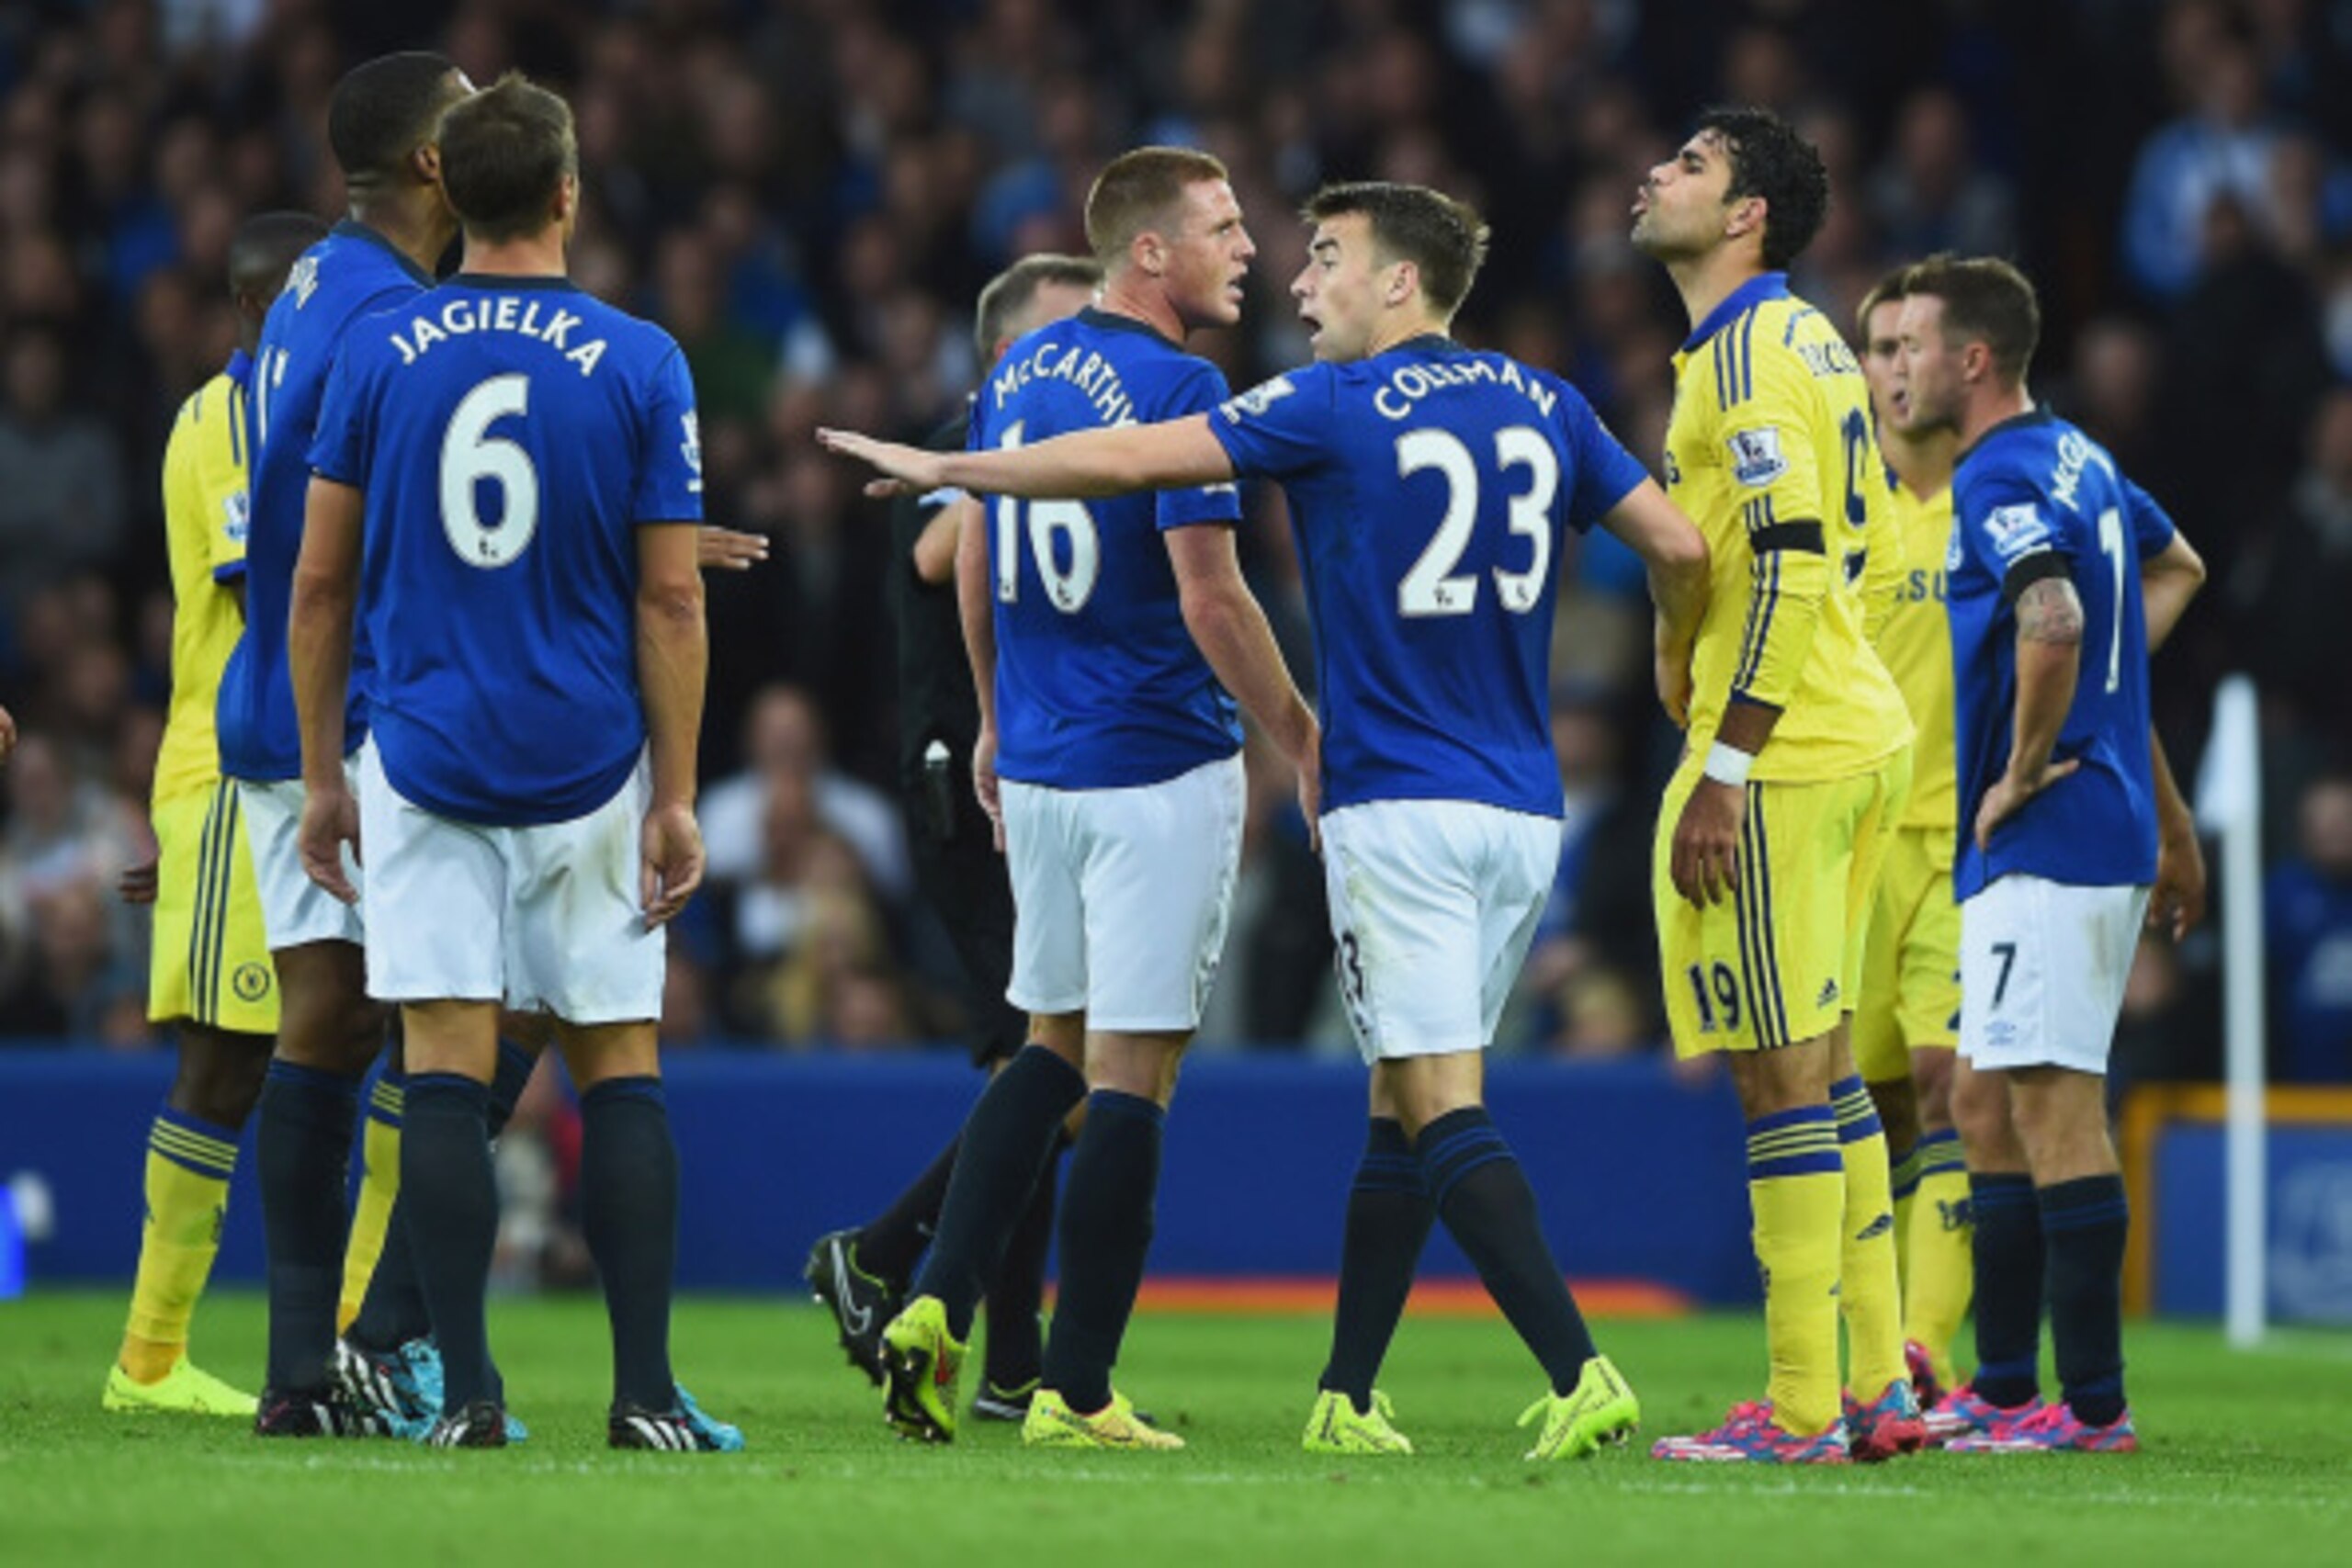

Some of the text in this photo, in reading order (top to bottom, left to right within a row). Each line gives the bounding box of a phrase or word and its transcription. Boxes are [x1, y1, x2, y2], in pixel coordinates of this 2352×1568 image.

[389, 297, 607, 377] JAGIELKA
[1374, 359, 1558, 420] COLEMAN
[439, 374, 538, 568] 6
[1394, 426, 1559, 616] 23
[1688, 960, 1740, 1032] 19
[1990, 942, 2018, 1011] 7
